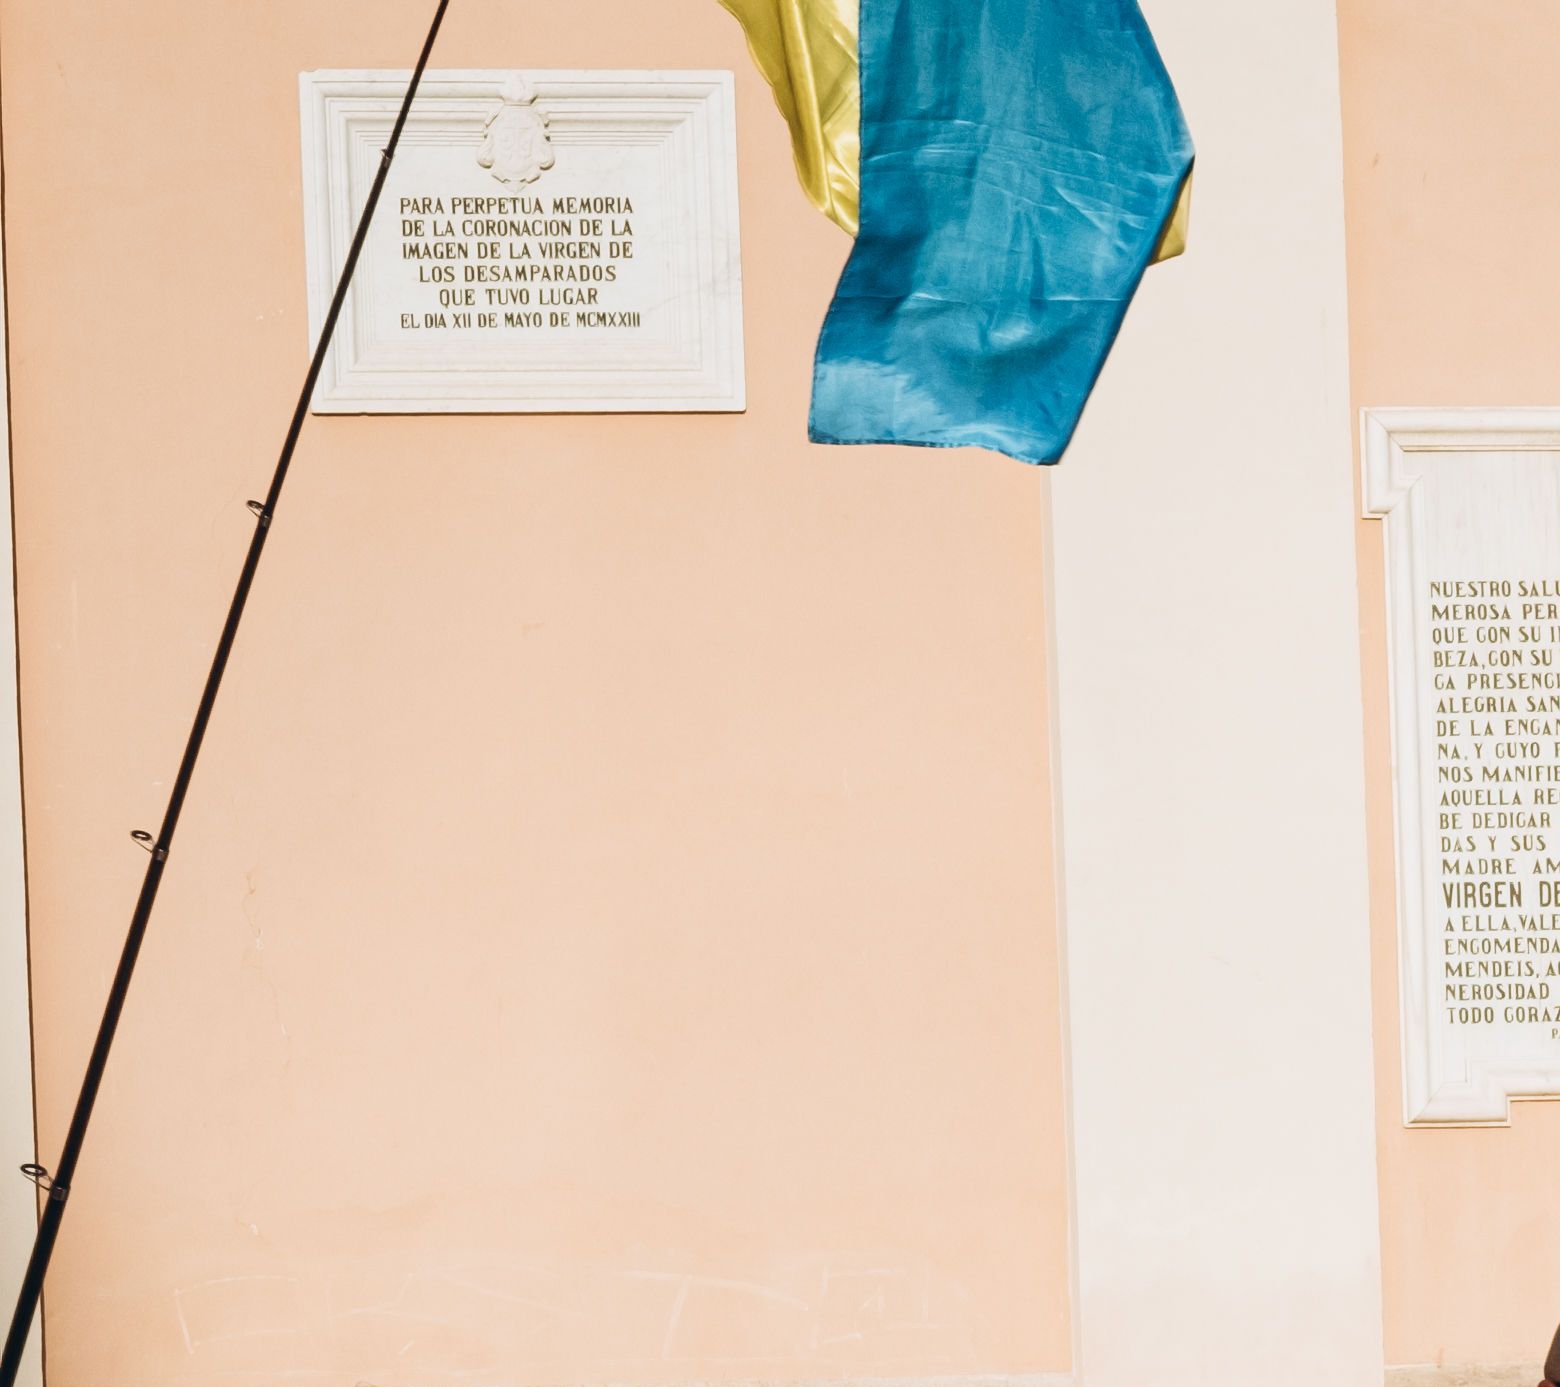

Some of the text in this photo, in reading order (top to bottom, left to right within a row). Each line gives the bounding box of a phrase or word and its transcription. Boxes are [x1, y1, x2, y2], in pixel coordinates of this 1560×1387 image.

[399, 197, 634, 215] PARA PERPETUA MEMORIA
[401, 219, 634, 237] DE LA CORONACION DE LA
[402, 241, 634, 259] IMAGEN DE LA VIRGEN DE
[419, 264, 617, 283] LOS DESAMPARADOS
[439, 288, 599, 309] QUE TUVO LUGAR
[400, 312, 641, 328] EL DIA XII DE MAYO DE MCMXXIII
[1429, 580, 1512, 598] NUESTRO
[1431, 603, 1513, 621] MEROSA
[1435, 696, 1518, 714] ALEGRIA
[1436, 720, 1461, 737] DE
[1470, 720, 1495, 736] LA
[1437, 743, 1469, 760] NA,
[1473, 743, 1484, 759] Y
[1437, 766, 1474, 783] NOS
[1439, 788, 1523, 807] AQUELLA
[1439, 813, 1463, 830] BE
[1440, 836, 1477, 853] DAS
[1487, 836, 1497, 852] Y
[1510, 834, 1547, 852] SUS
[1442, 858, 1517, 875] MADRE
[1441, 881, 1523, 909] VIRGEN
[1445, 983, 1550, 1001] NEROSIDAD
[1446, 1007, 1495, 1024] TODO
